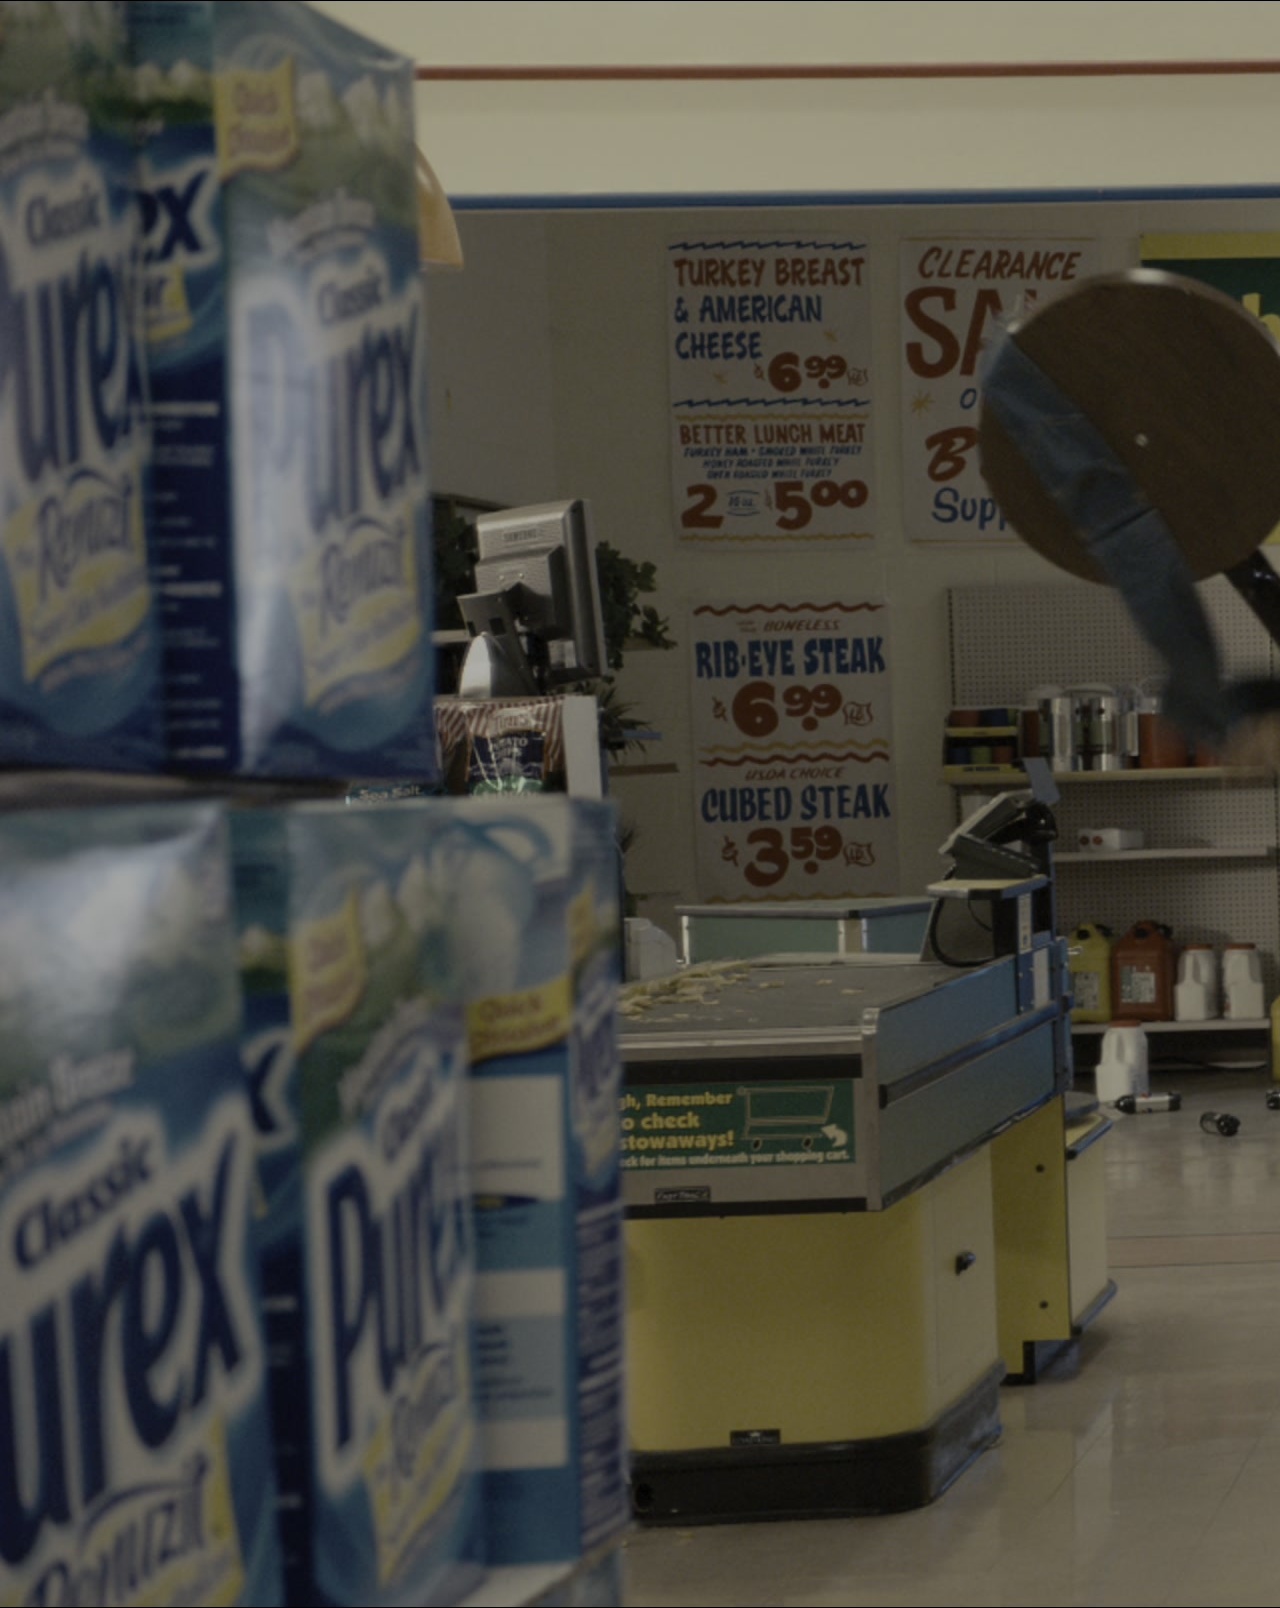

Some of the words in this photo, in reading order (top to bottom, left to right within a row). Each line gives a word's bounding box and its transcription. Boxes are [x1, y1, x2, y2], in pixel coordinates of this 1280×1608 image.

[674, 258, 764, 287] TURKEY
[775, 257, 866, 286] BREAST
[917, 247, 1082, 281] CLEARANCE
[674, 298, 689, 323] &
[700, 295, 823, 323] AMERICAN
[675, 332, 763, 360] CHEESE
[680, 424, 747, 445] BETTER
[753, 423, 813, 444] LUNCH
[819, 423, 866, 443] MEAT
[684, 447, 722, 458] TURKEY
[724, 446, 749, 458] HAM
[758, 446, 797, 457] SMOKED
[799, 445, 827, 456] WHITE
[829, 445, 862, 455] TURKEY
[805, 457, 840, 467] TURKEY
[800, 468, 833, 478] TURKEY
[681, 483, 725, 529] 2
[763, 619, 841, 633] BONELESS
[803, 635, 886, 676] STEAK
[745, 768, 786, 781] USDA
[789, 766, 846, 780] CHOICE
[702, 786, 793, 823] CUBED
[801, 783, 891, 821] STEAK
[645, 1090, 734, 1108] Remember
[640, 1110, 701, 1130] check
[688, 1151, 749, 1166] underneath
[749, 1152, 775, 1165] your
[775, 1149, 825, 1164] shopping
